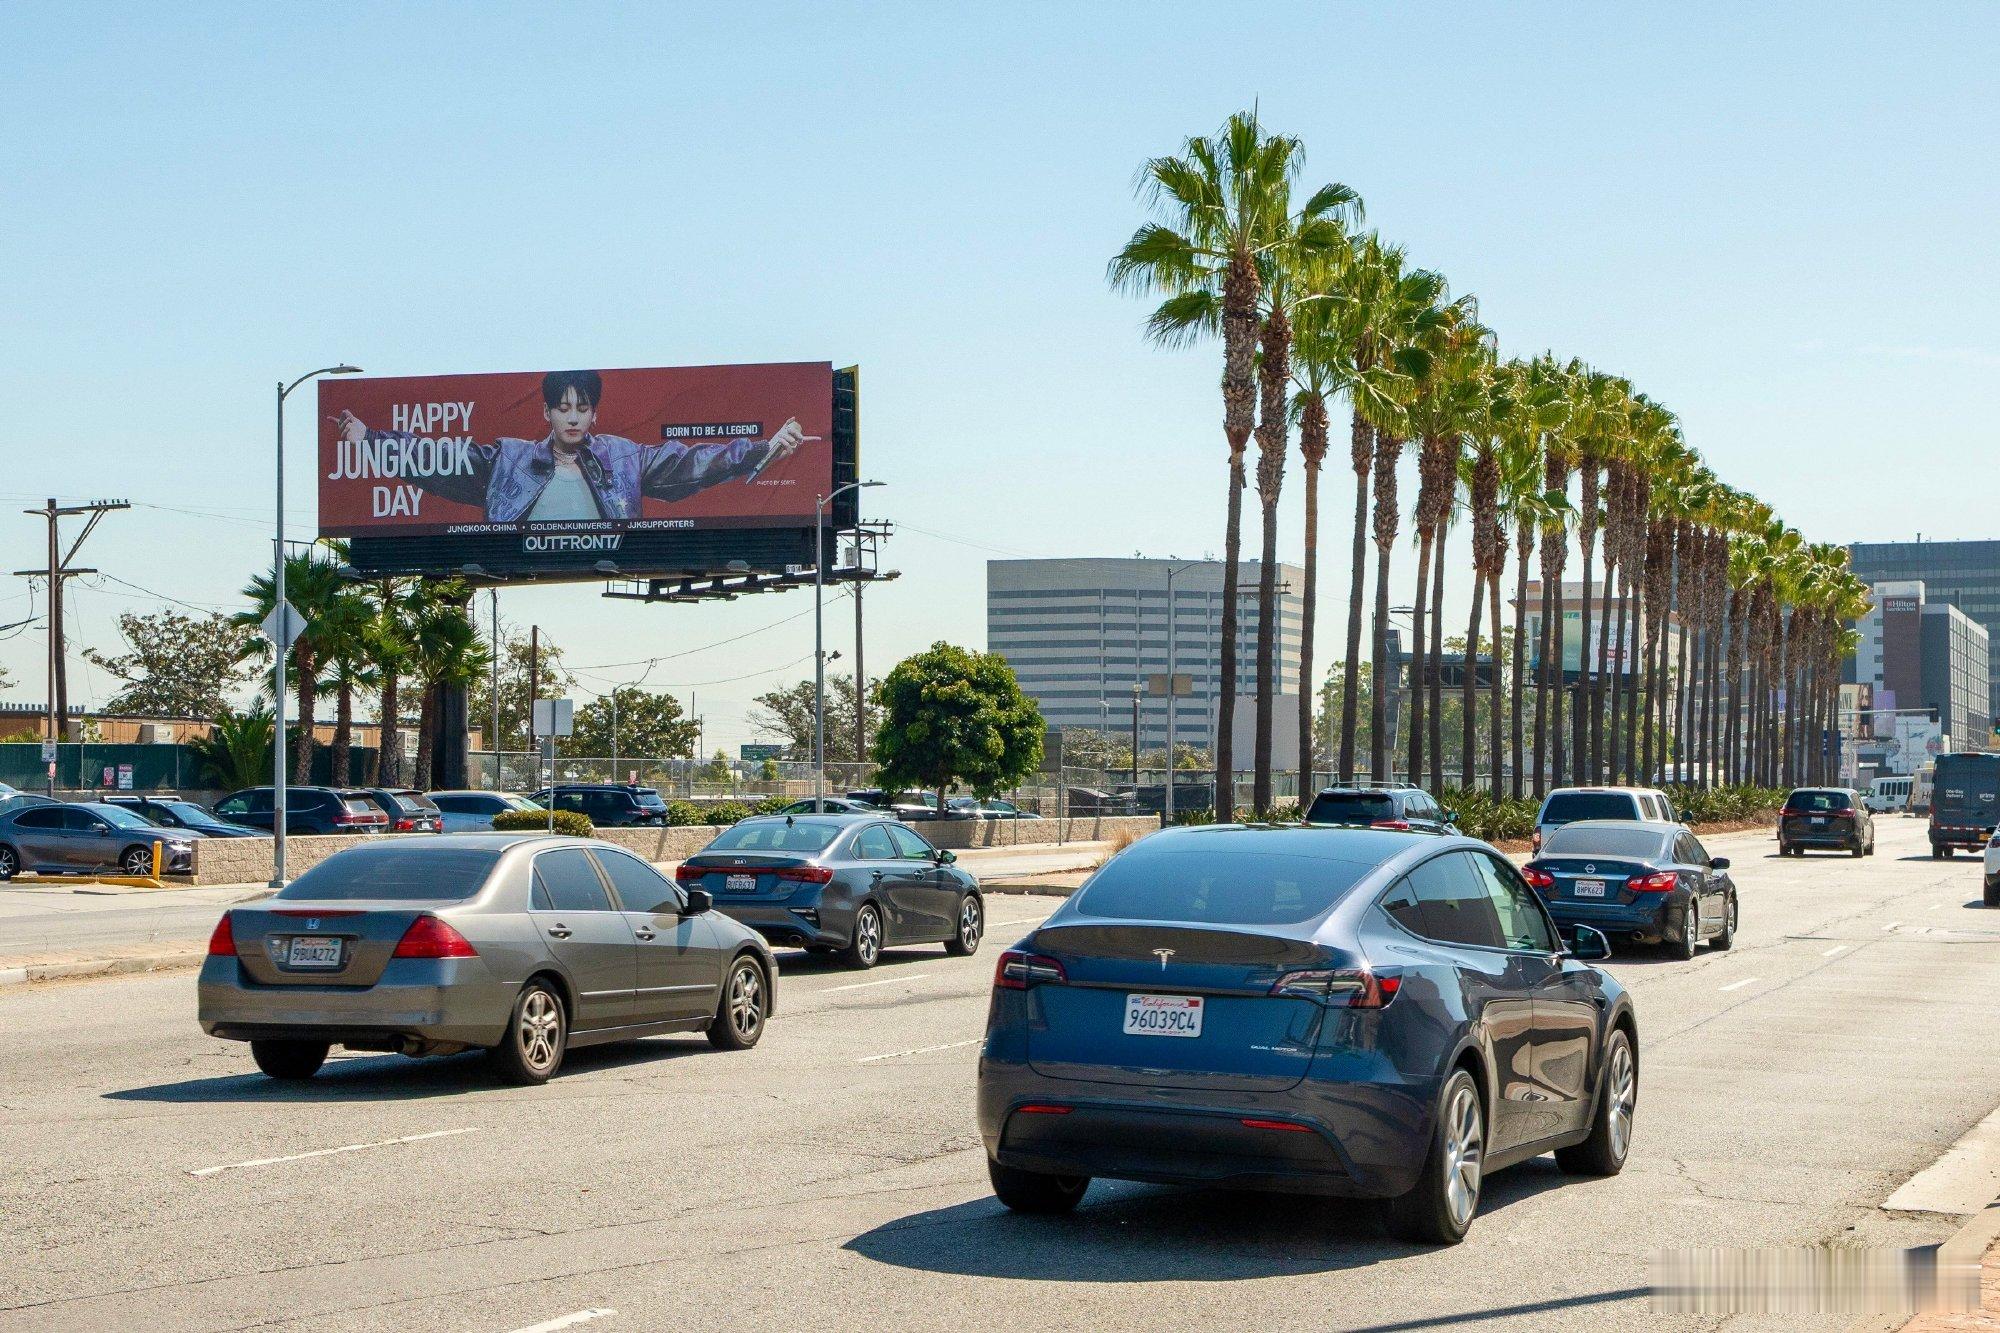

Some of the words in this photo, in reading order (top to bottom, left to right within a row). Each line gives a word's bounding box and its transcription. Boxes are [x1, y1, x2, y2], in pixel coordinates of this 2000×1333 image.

[392, 402, 475, 434] HAPPY
[666, 426, 690, 437] BORN
[692, 426, 703, 436] TO
[705, 426, 716, 436] BE
[717, 425, 724, 435] A
[726, 424, 758, 435] LEGEND
[328, 436, 475, 480] JUNGKOOK
[373, 485, 424, 518] DAY
[447, 524, 491, 533] JUNGKOOK
[492, 523, 517, 532] CHINA
[530, 521, 612, 531] GOLDENJKUNIVERSE
[627, 520, 695, 530] JJKSUPPORTERS
[1892, 600, 1916, 608] Hilton
[1141, 997, 1188, 1009] California
[1129, 1009, 1195, 1031] 96039C4
